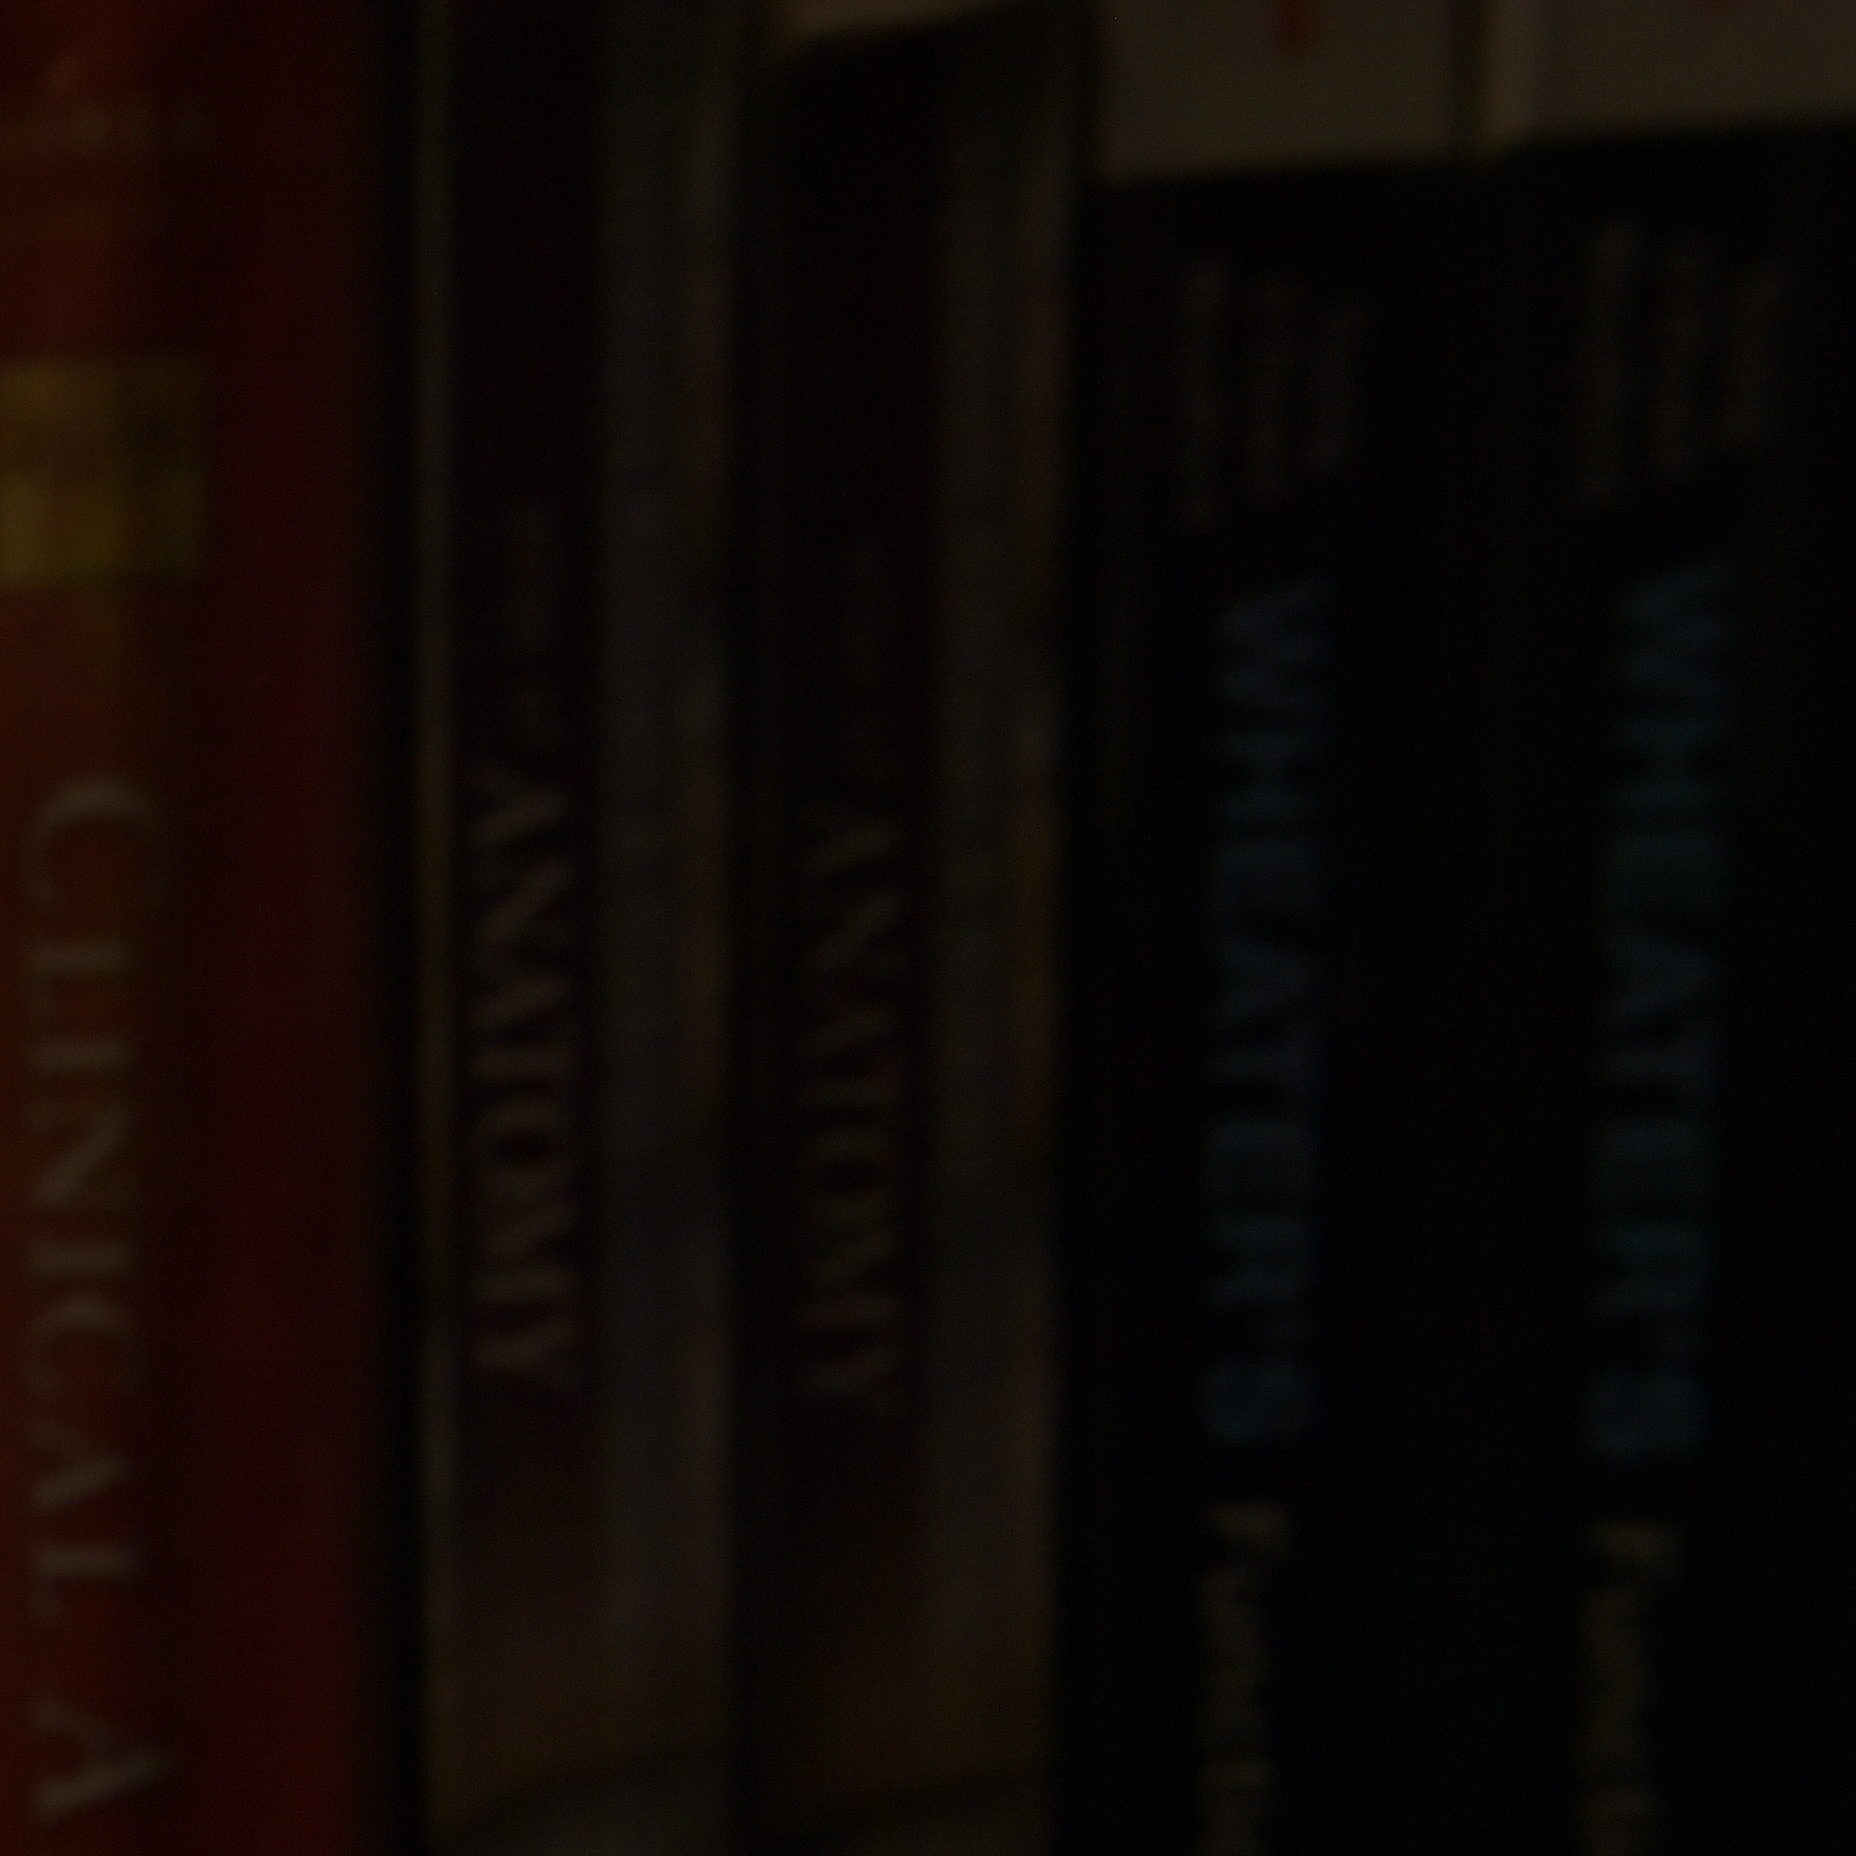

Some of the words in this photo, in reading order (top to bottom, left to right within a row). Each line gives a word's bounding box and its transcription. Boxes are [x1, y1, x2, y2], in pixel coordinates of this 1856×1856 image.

[18, 770, 182, 1630] CLINICAL
[470, 756, 588, 1398] ANATOMY
[793, 793, 908, 1418] ANATOMY
[1188, 570, 1338, 1452] WHEATER'S
[1576, 550, 1750, 1474] WHEATER'S
